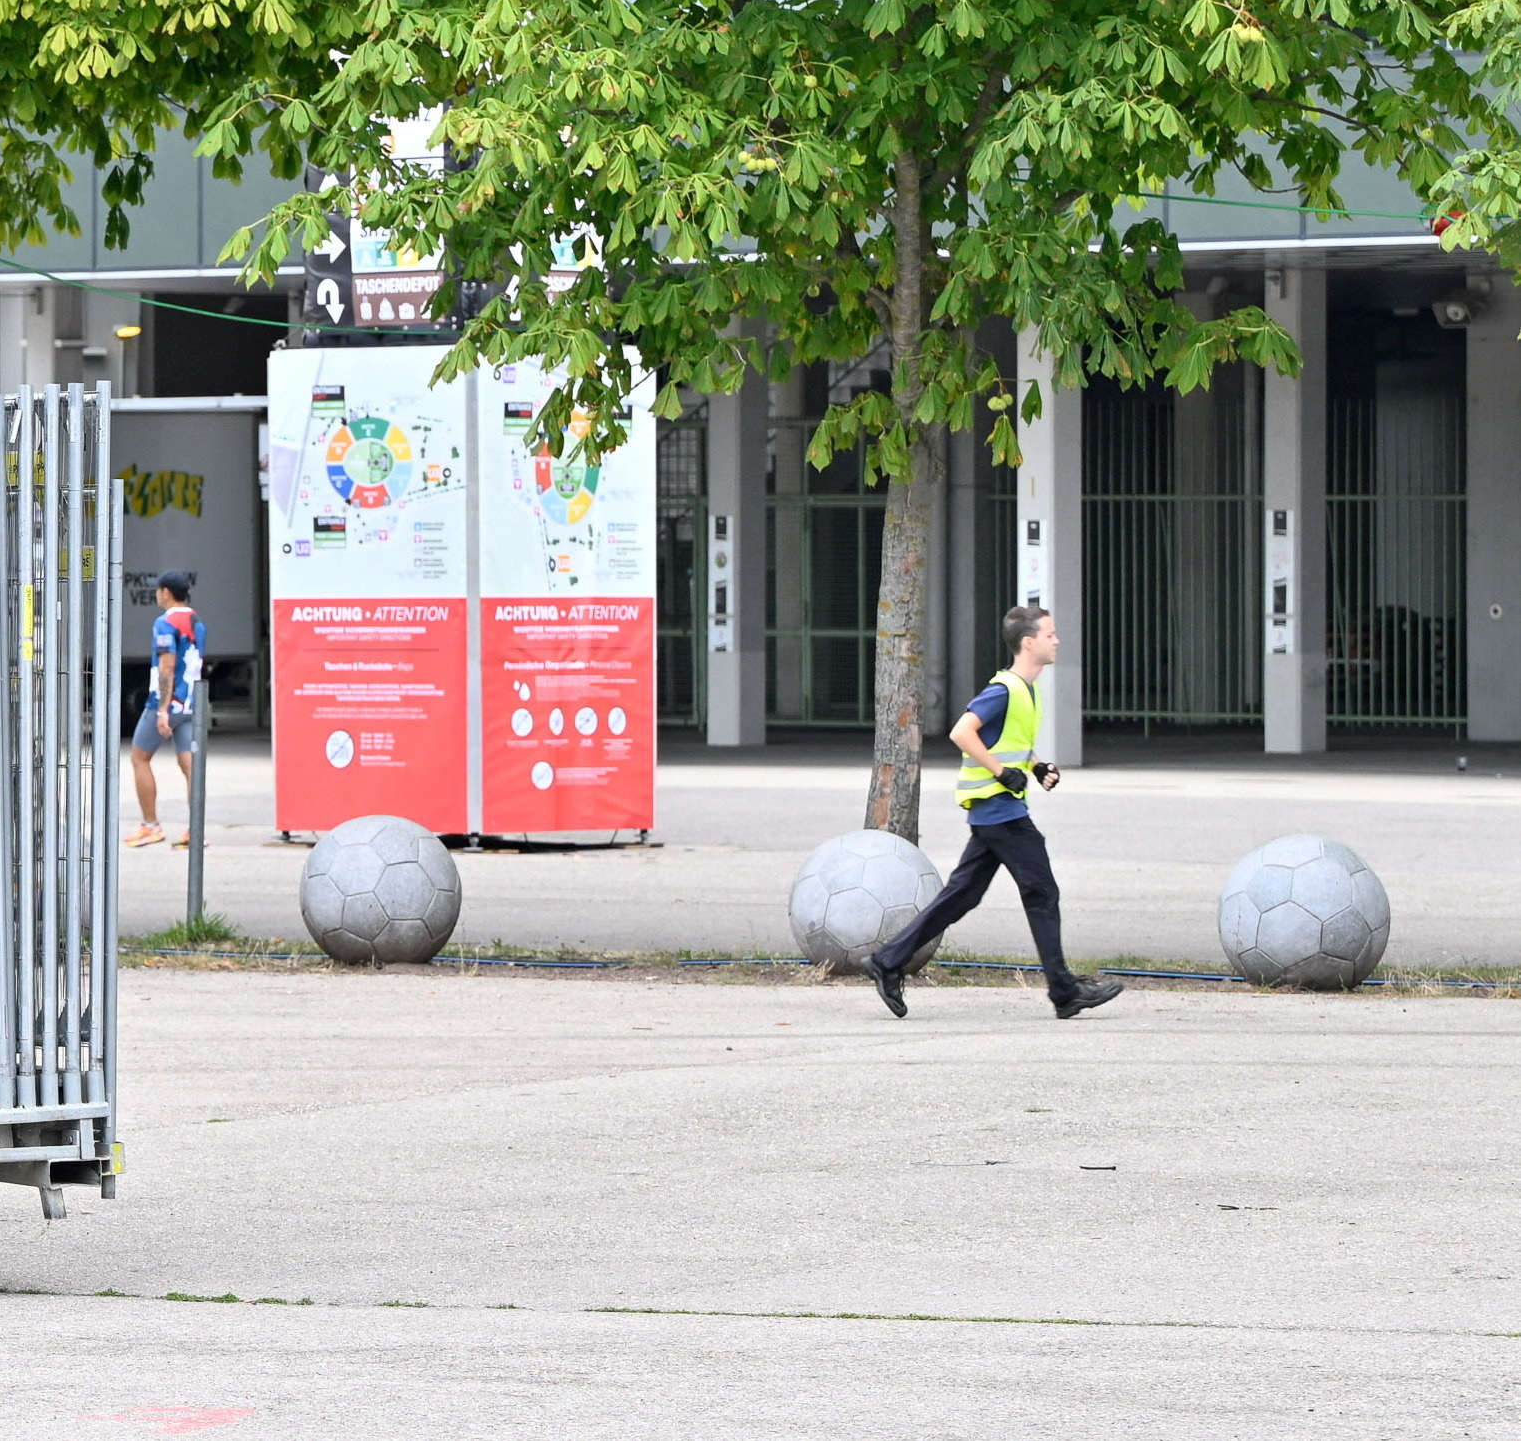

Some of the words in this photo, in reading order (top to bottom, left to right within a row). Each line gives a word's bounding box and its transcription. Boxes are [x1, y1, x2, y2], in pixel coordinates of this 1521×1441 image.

[355, 275, 441, 295] TASCHENDEPOT
[291, 606, 362, 622] ACHTUNG
[372, 606, 450, 621] ATTENTION
[495, 605, 559, 621] ACHTUNG
[568, 605, 639, 620] ATTENTION
